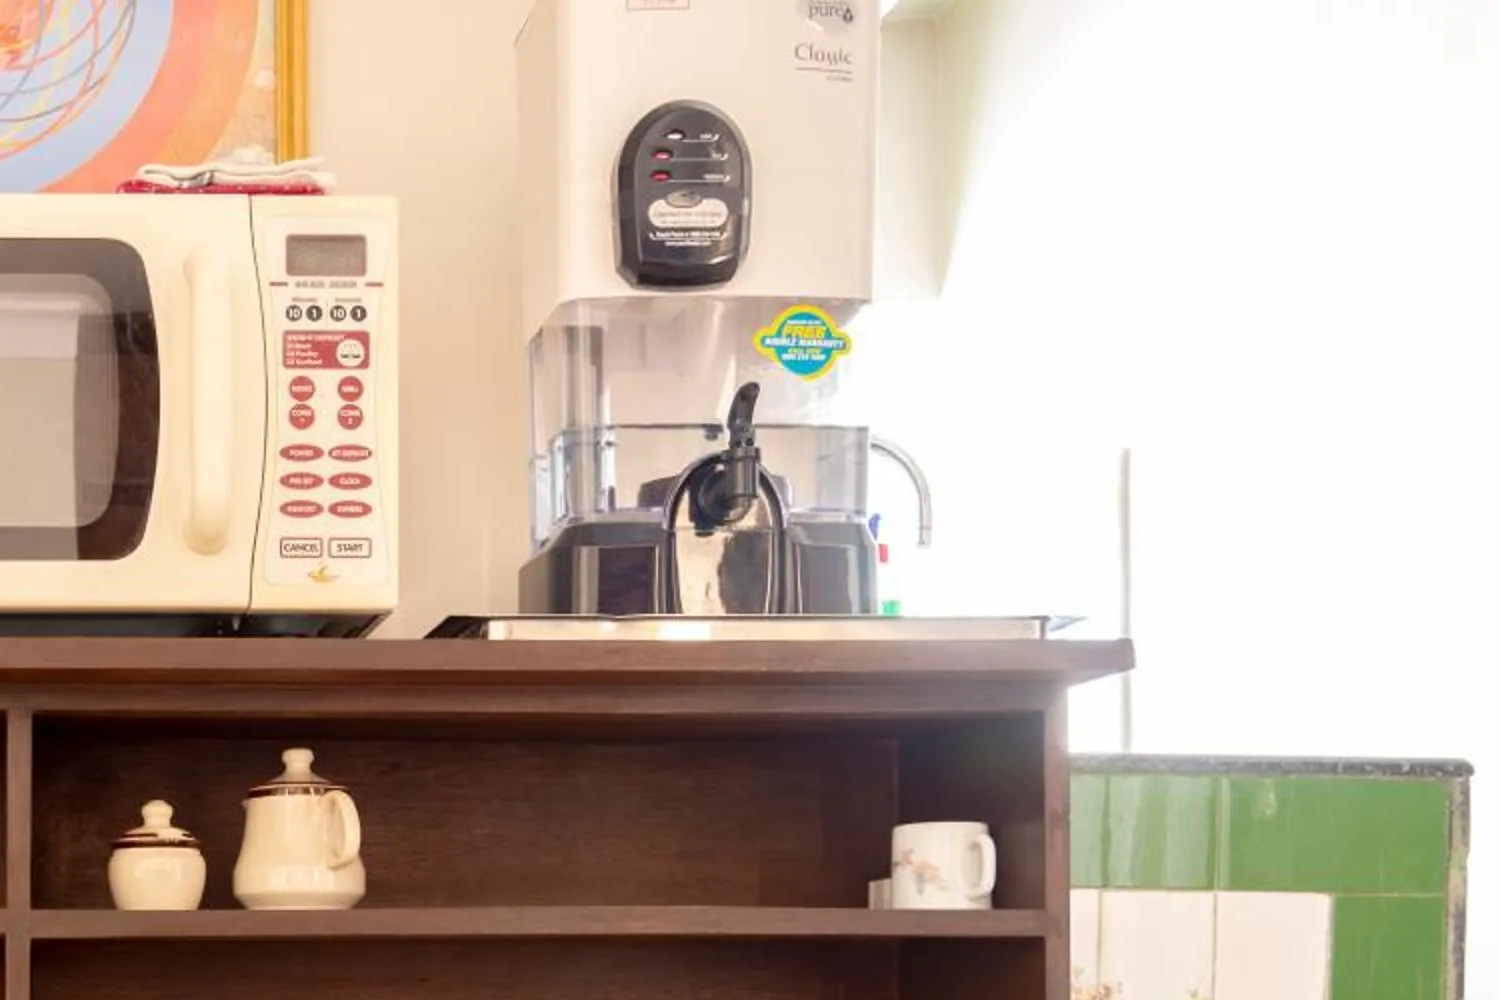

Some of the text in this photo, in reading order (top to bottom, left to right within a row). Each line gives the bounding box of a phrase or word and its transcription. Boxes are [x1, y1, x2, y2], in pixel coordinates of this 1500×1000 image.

[289, 307, 300, 318] 10
[334, 307, 345, 318] 10
[784, 326, 826, 338] FREE
[283, 542, 319, 553] CANCEL
[336, 542, 364, 553] START
